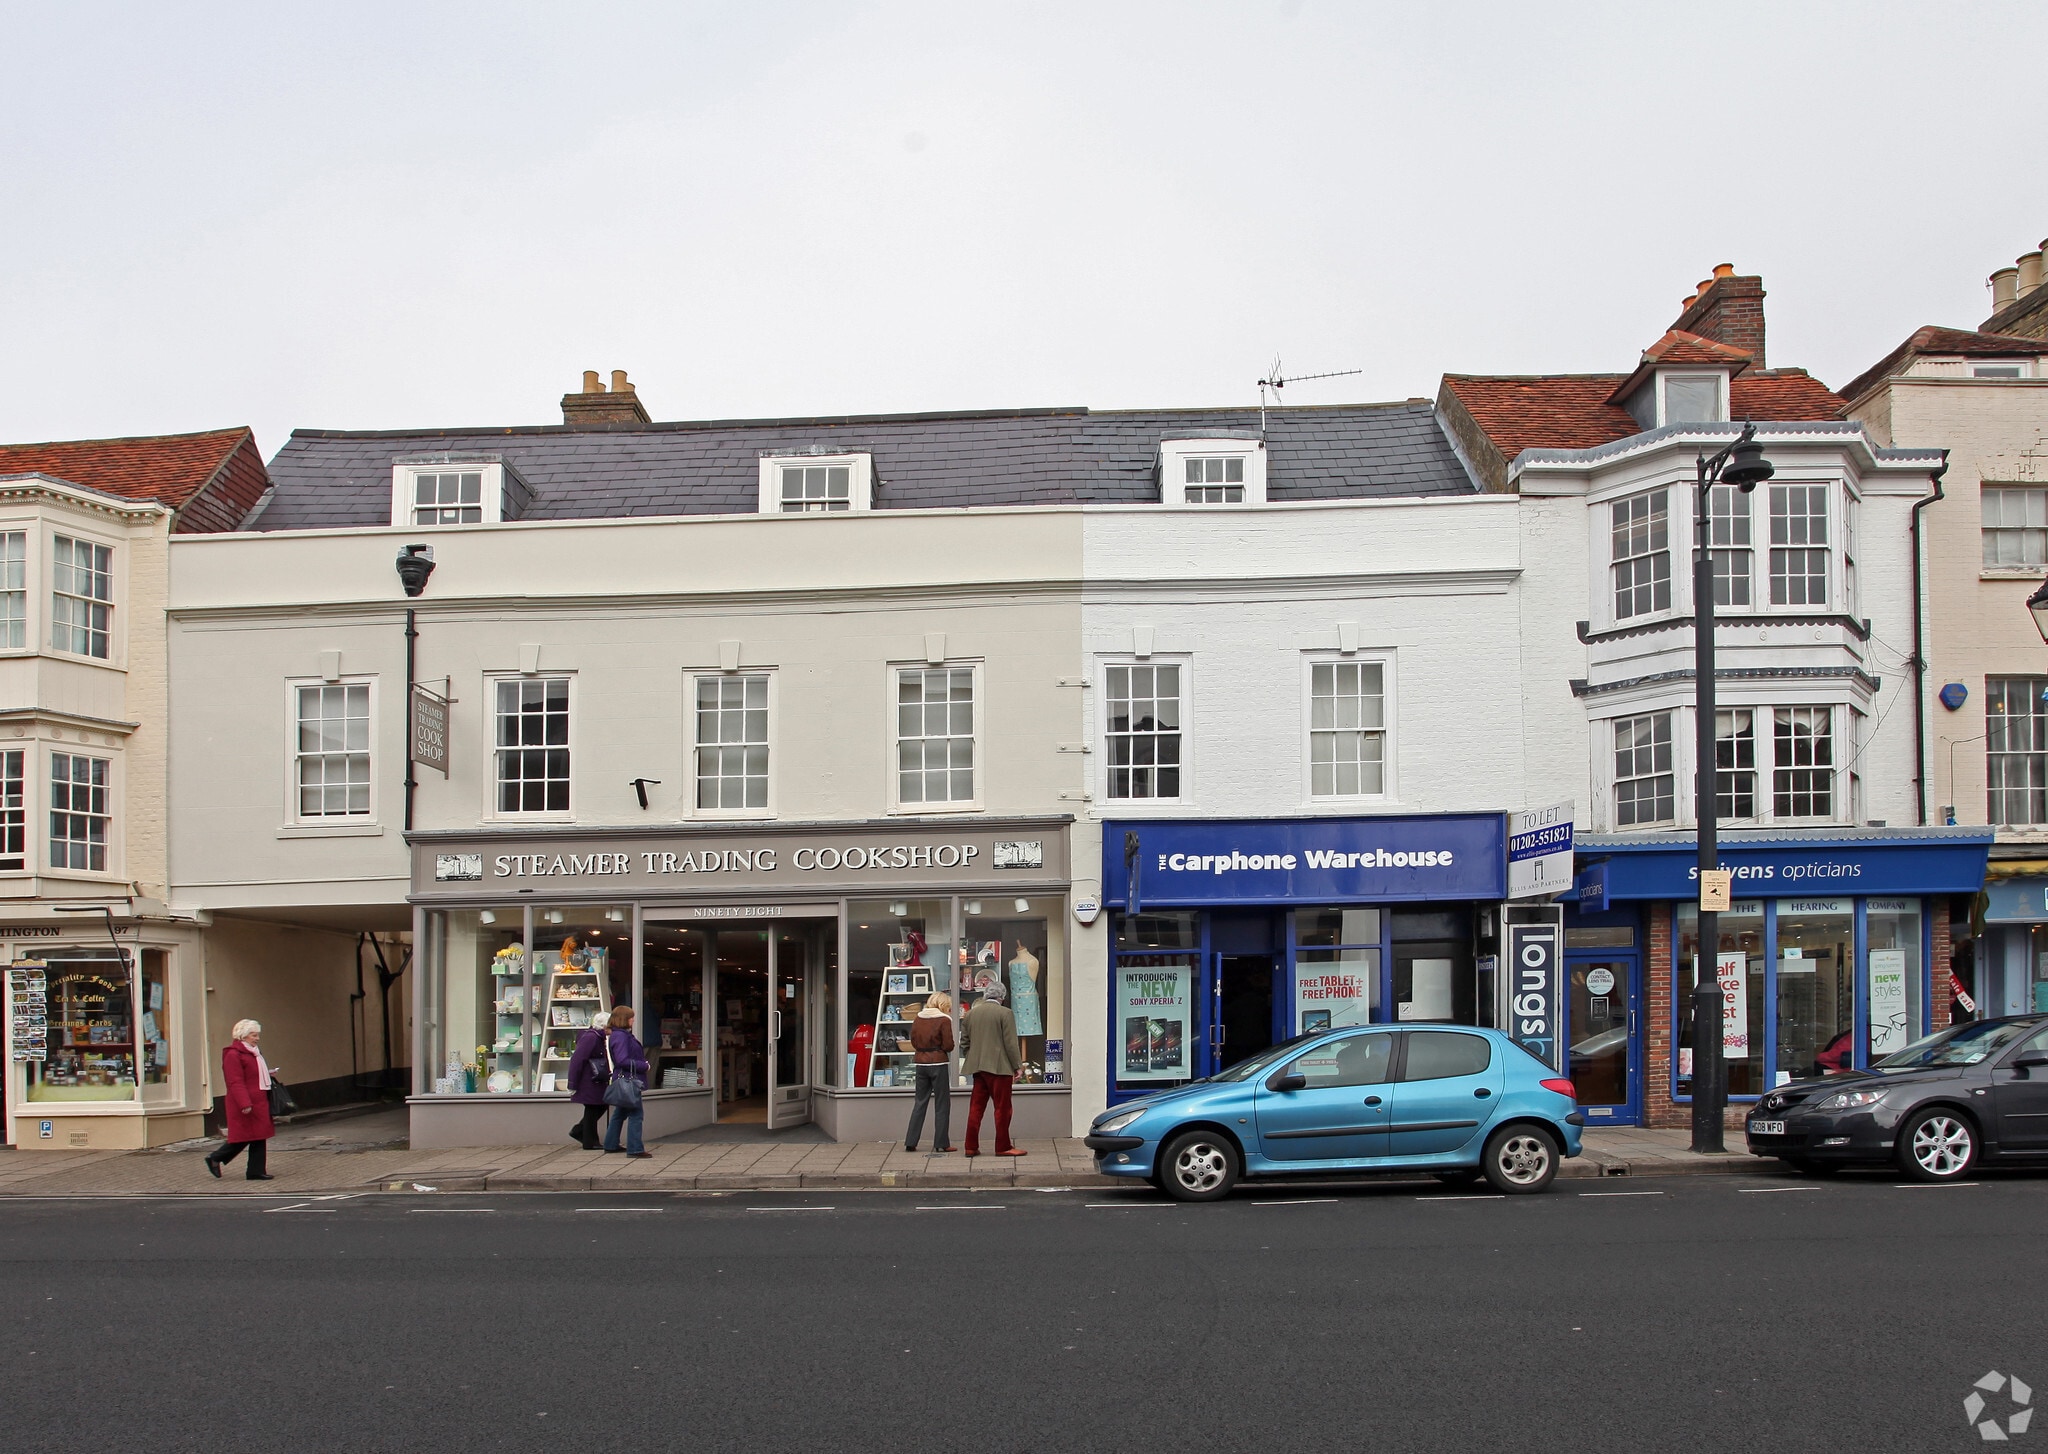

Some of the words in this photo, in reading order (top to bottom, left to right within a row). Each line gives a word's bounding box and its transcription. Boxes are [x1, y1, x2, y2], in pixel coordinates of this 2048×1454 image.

[417, 701, 443, 720] STEAMER
[417, 713, 443, 732] TRADING
[417, 725, 443, 747] COOK
[417, 740, 443, 761] SHOP
[1522, 812, 1537, 829] TO
[1539, 806, 1560, 825] LET
[1510, 825, 1570, 852] 01202-551821
[493, 853, 631, 877] STEAMER
[641, 849, 778, 874] TRADING
[793, 844, 979, 871] COOKSHOP
[1158, 854, 1167, 871] THE
[1168, 850, 1297, 875] Carphone
[1304, 848, 1453, 869] Warehouse
[1782, 861, 1862, 881] opticians
[1510, 885, 1527, 893] ELLIS
[1540, 877, 1570, 888] PARTNERS
[1579, 883, 1603, 900] opticians
[694, 907, 741, 918] NINETY
[744, 906, 784, 916] EIGHT
[1735, 904, 1757, 913] THE
[1791, 902, 1838, 911] HEARING
[1866, 901, 1906, 910] COMPANY
[114, 926, 129, 935] 97
[1716, 961, 1736, 976] alf
[89, 975, 118, 992] Foods
[1126, 973, 1178, 982] INTRODUCING
[1299, 979, 1318, 987] FREE
[1319, 975, 1356, 986] TABLET
[1874, 973, 1900, 984] new
[1140, 981, 1176, 998] NEW
[1302, 989, 1324, 999] FREE
[1325, 986, 1363, 998] PHONE
[1874, 983, 1902, 999] styles
[54, 994, 69, 1003] Tea
[72, 994, 79, 1003] &
[82, 993, 106, 1003] Coffee
[1130, 998, 1147, 1006] SONY
[1150, 997, 1174, 1005] XPERIA
[1178, 997, 1182, 1005] Z
[1960, 995, 1973, 1009] sale
[88, 1019, 113, 1027] Cards
[43, 1122, 50, 1130] P
[1767, 1122, 1783, 1132] WFO
